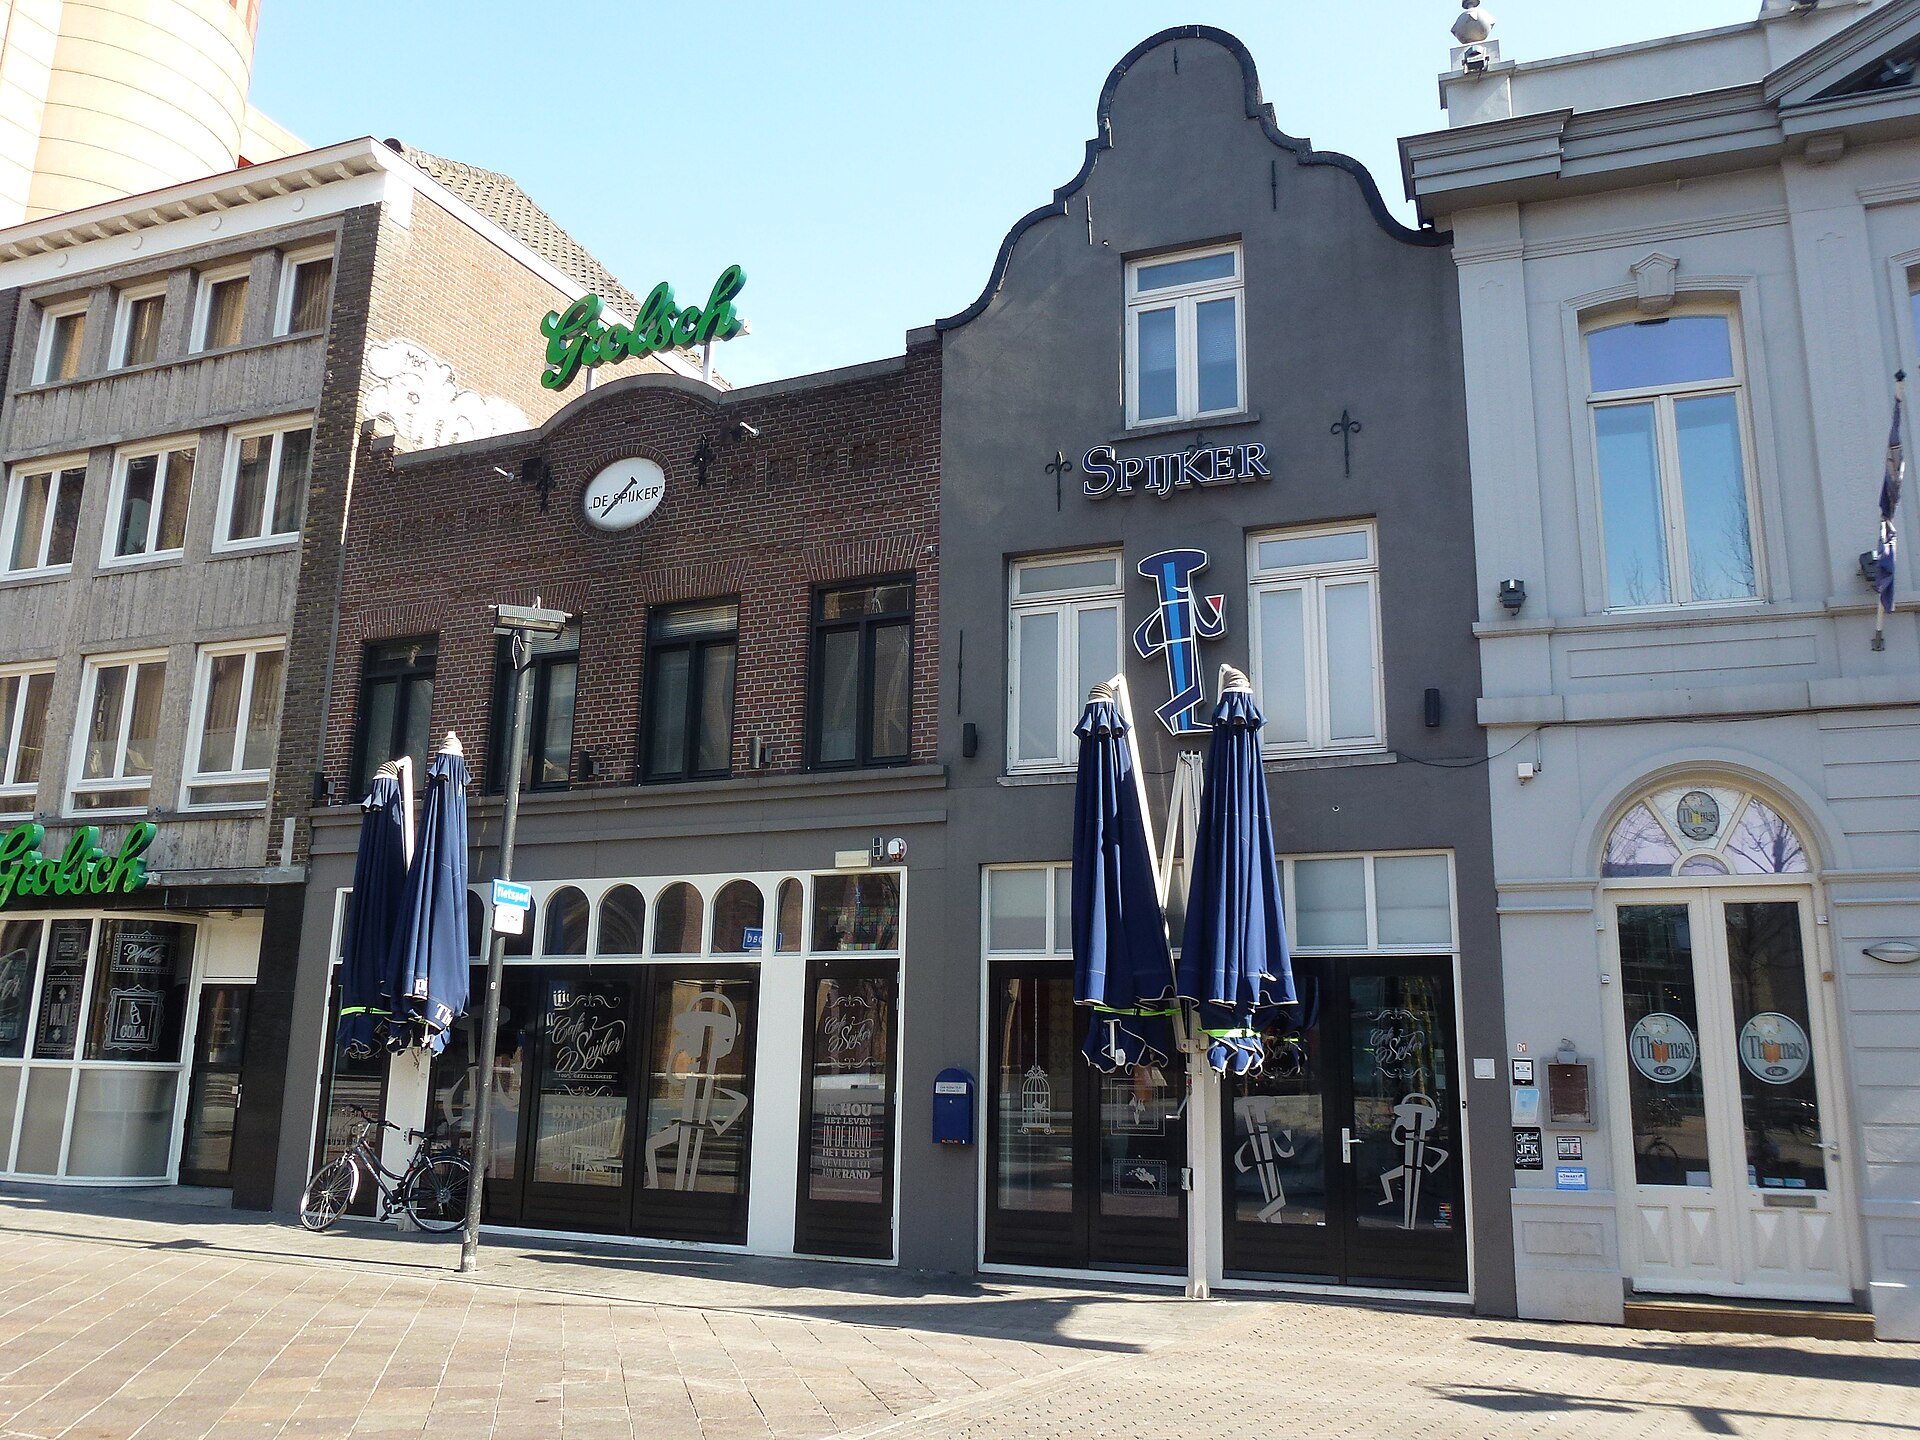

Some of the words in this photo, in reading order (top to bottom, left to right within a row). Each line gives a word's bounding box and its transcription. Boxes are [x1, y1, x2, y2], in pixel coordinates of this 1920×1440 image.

[541, 265, 744, 391] Grolsch
[1082, 442, 1271, 496] SPIJKER
[120, 1025, 146, 1039] COLA
[824, 1103, 837, 1116] IK
[840, 1103, 873, 1117] HOU
[824, 1116, 841, 1125] HET
[843, 1117, 871, 1126] LEVEN
[823, 1126, 832, 1147] IN
[834, 1126, 845, 1148] DE
[847, 1126, 871, 1149] HAND
[822, 1148, 840, 1157] HET
[841, 1149, 871, 1158] LIEFST
[1517, 1144, 1538, 1154] JFK
[842, 1169, 871, 1180] RAND
